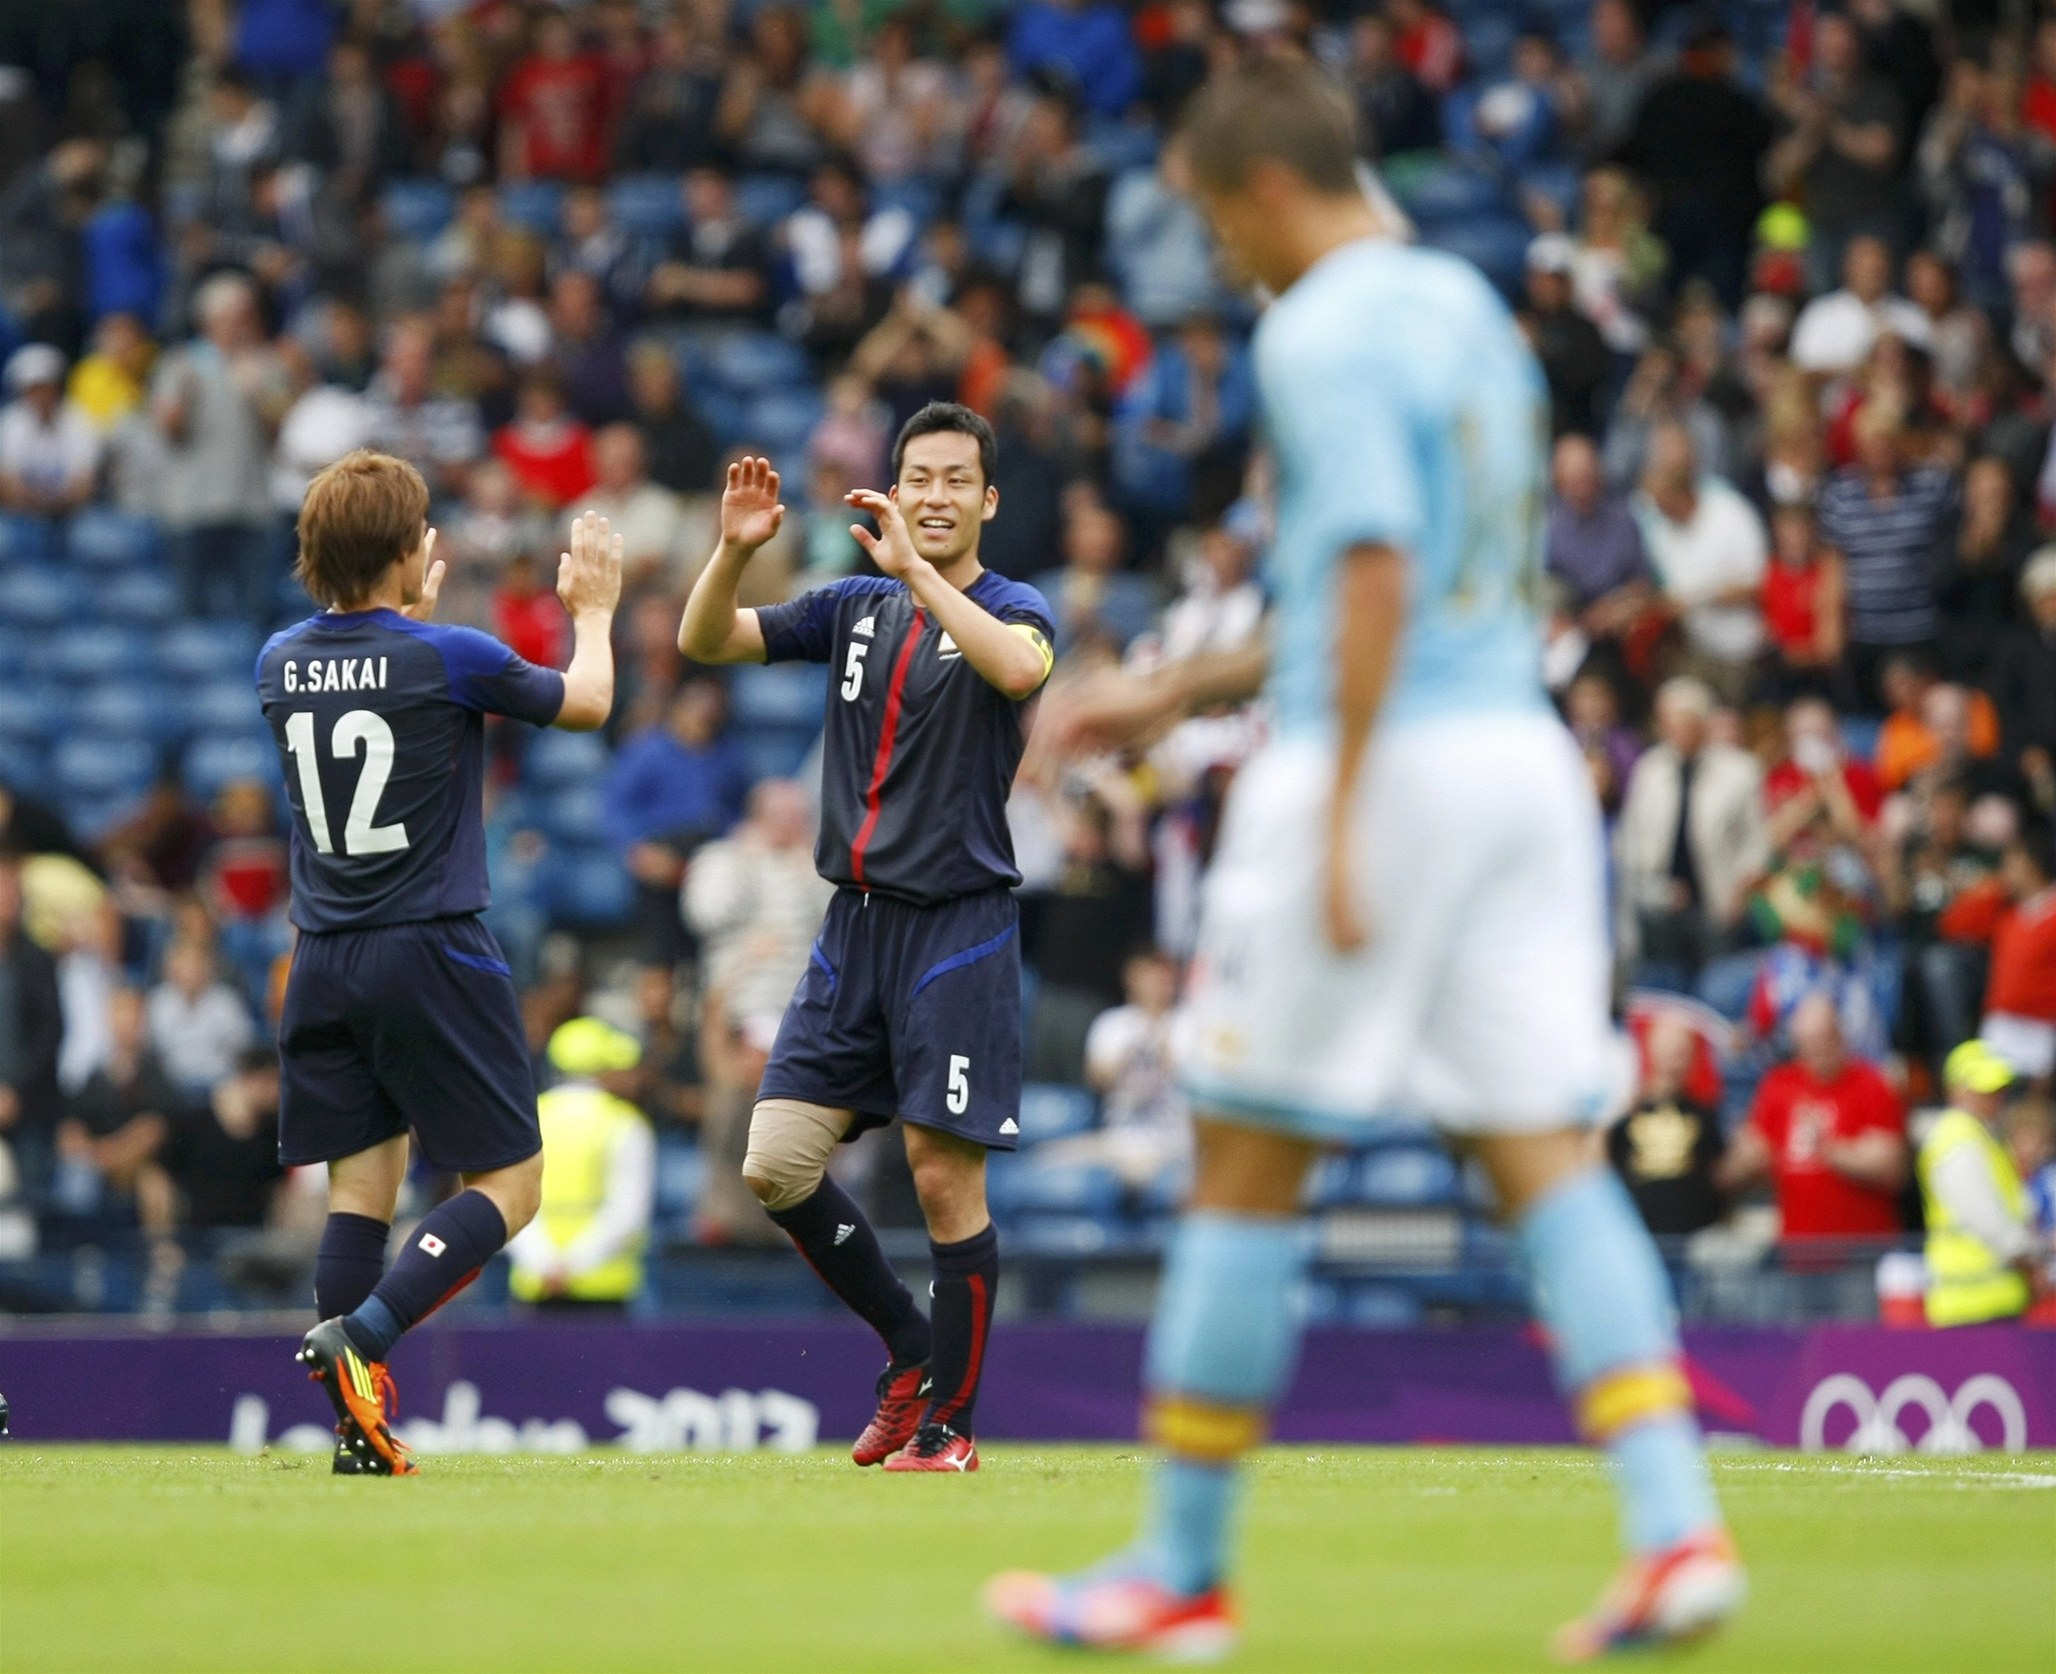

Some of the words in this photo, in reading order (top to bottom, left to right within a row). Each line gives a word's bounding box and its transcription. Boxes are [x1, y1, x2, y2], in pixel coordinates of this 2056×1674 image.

[284, 656, 388, 692] G.SAKAI
[840, 641, 868, 701] 5
[284, 709, 410, 855] 12
[946, 1054, 970, 1115] 5
